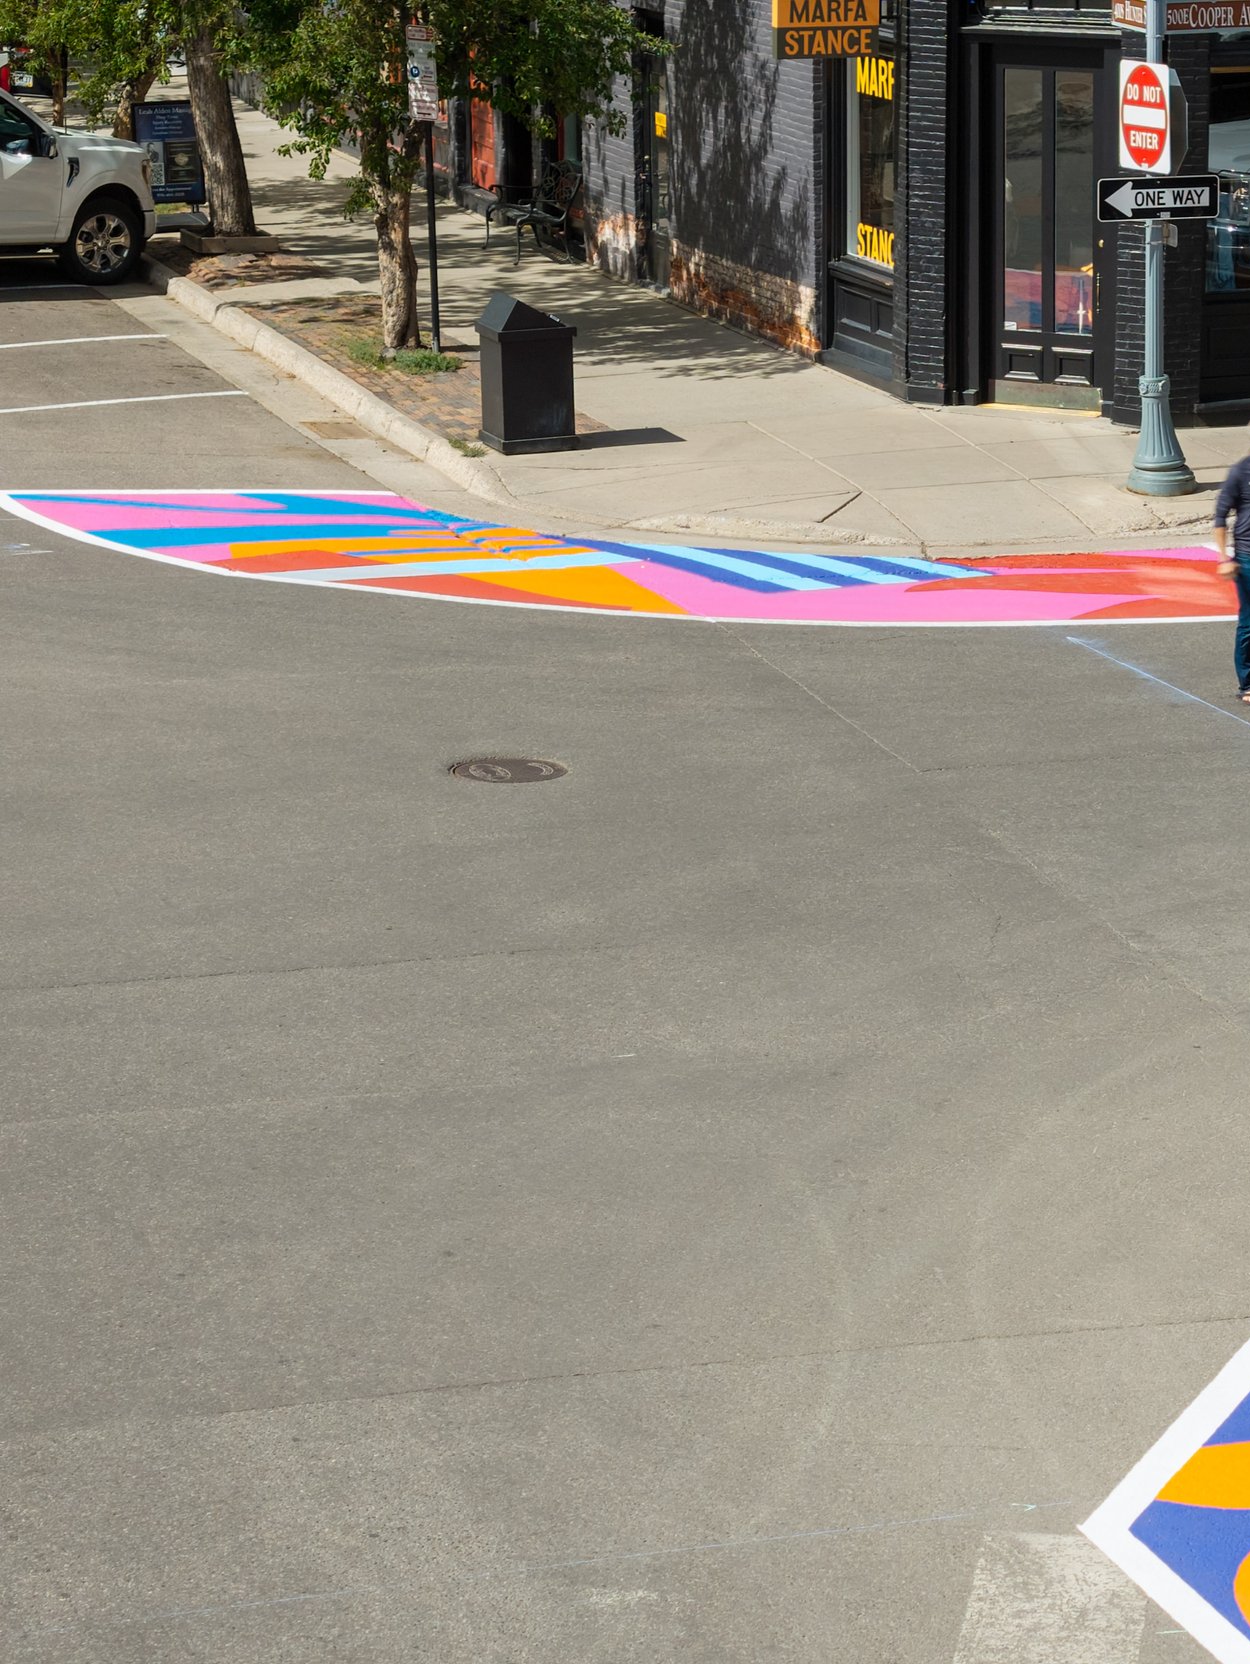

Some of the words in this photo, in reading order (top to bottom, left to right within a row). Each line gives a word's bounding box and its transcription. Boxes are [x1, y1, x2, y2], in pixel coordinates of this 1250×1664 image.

[790, 0, 868, 23] MARFA
[784, 28, 873, 56] STANCE
[856, 56, 895, 100] MARF
[1127, 83, 1139, 101] DO
[1143, 86, 1161, 103] NOT
[1130, 130, 1159, 150] ENTER
[1134, 190, 1166, 207] ONE
[1172, 189, 1205, 205] WAY
[856, 222, 895, 267] STANC
